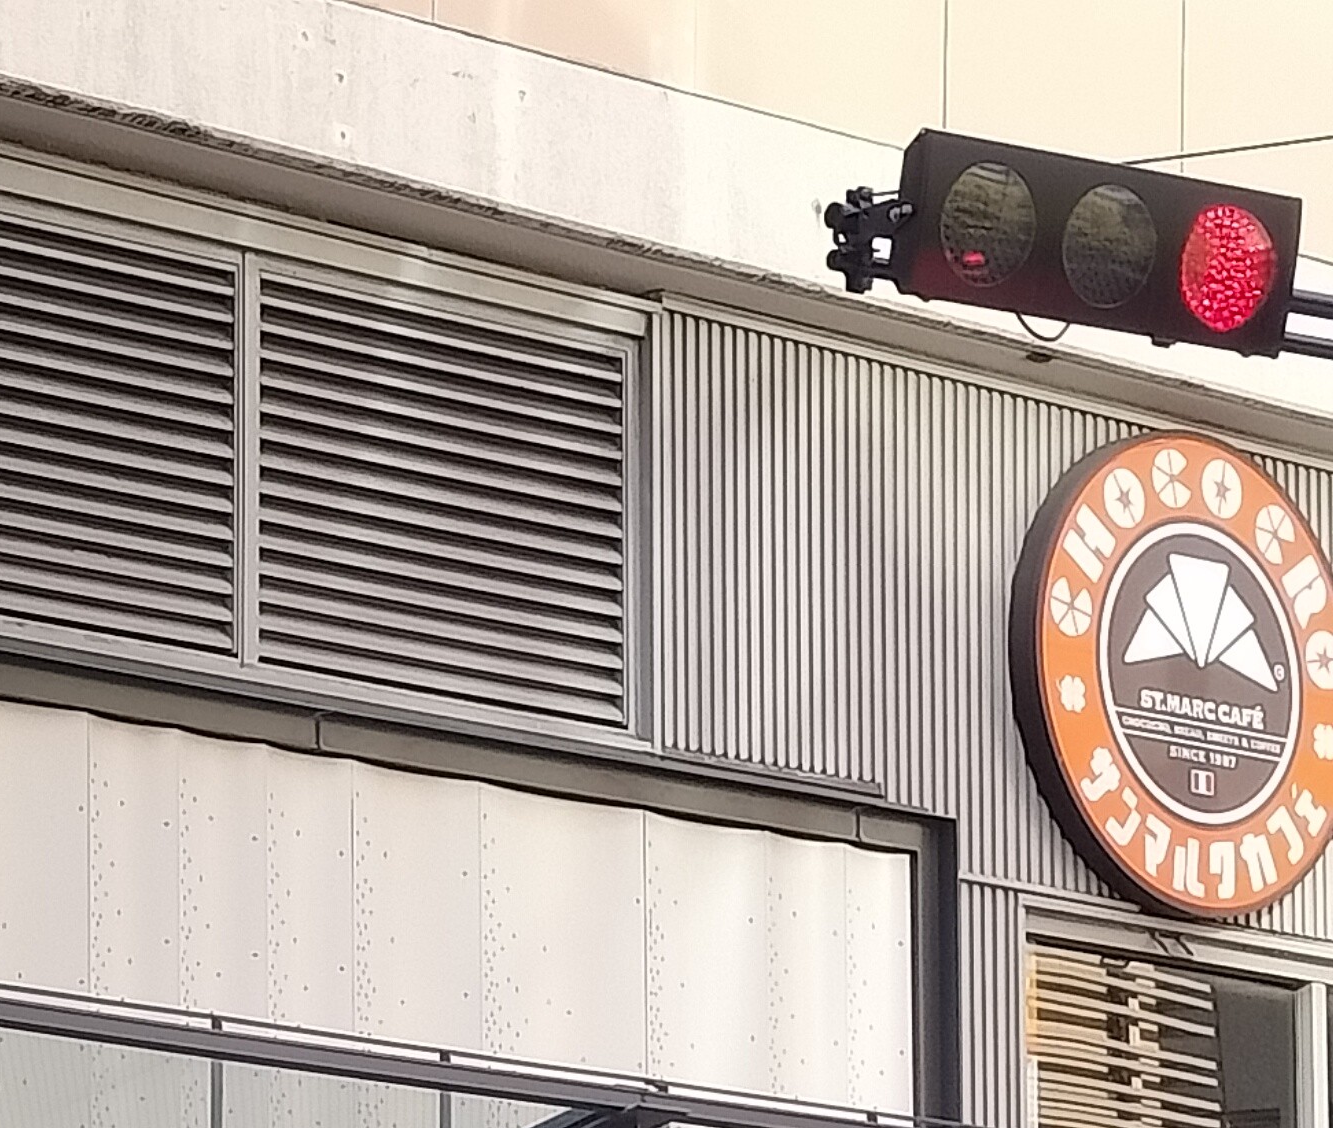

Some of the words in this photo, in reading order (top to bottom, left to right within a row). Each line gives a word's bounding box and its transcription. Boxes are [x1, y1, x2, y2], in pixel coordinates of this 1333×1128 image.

[1140, 689, 1216, 721] ST.MARC
[1217, 703, 1264, 730] CAFÉ
[1169, 745, 1207, 764] SINCE
[1209, 751, 1237, 769] 1987
